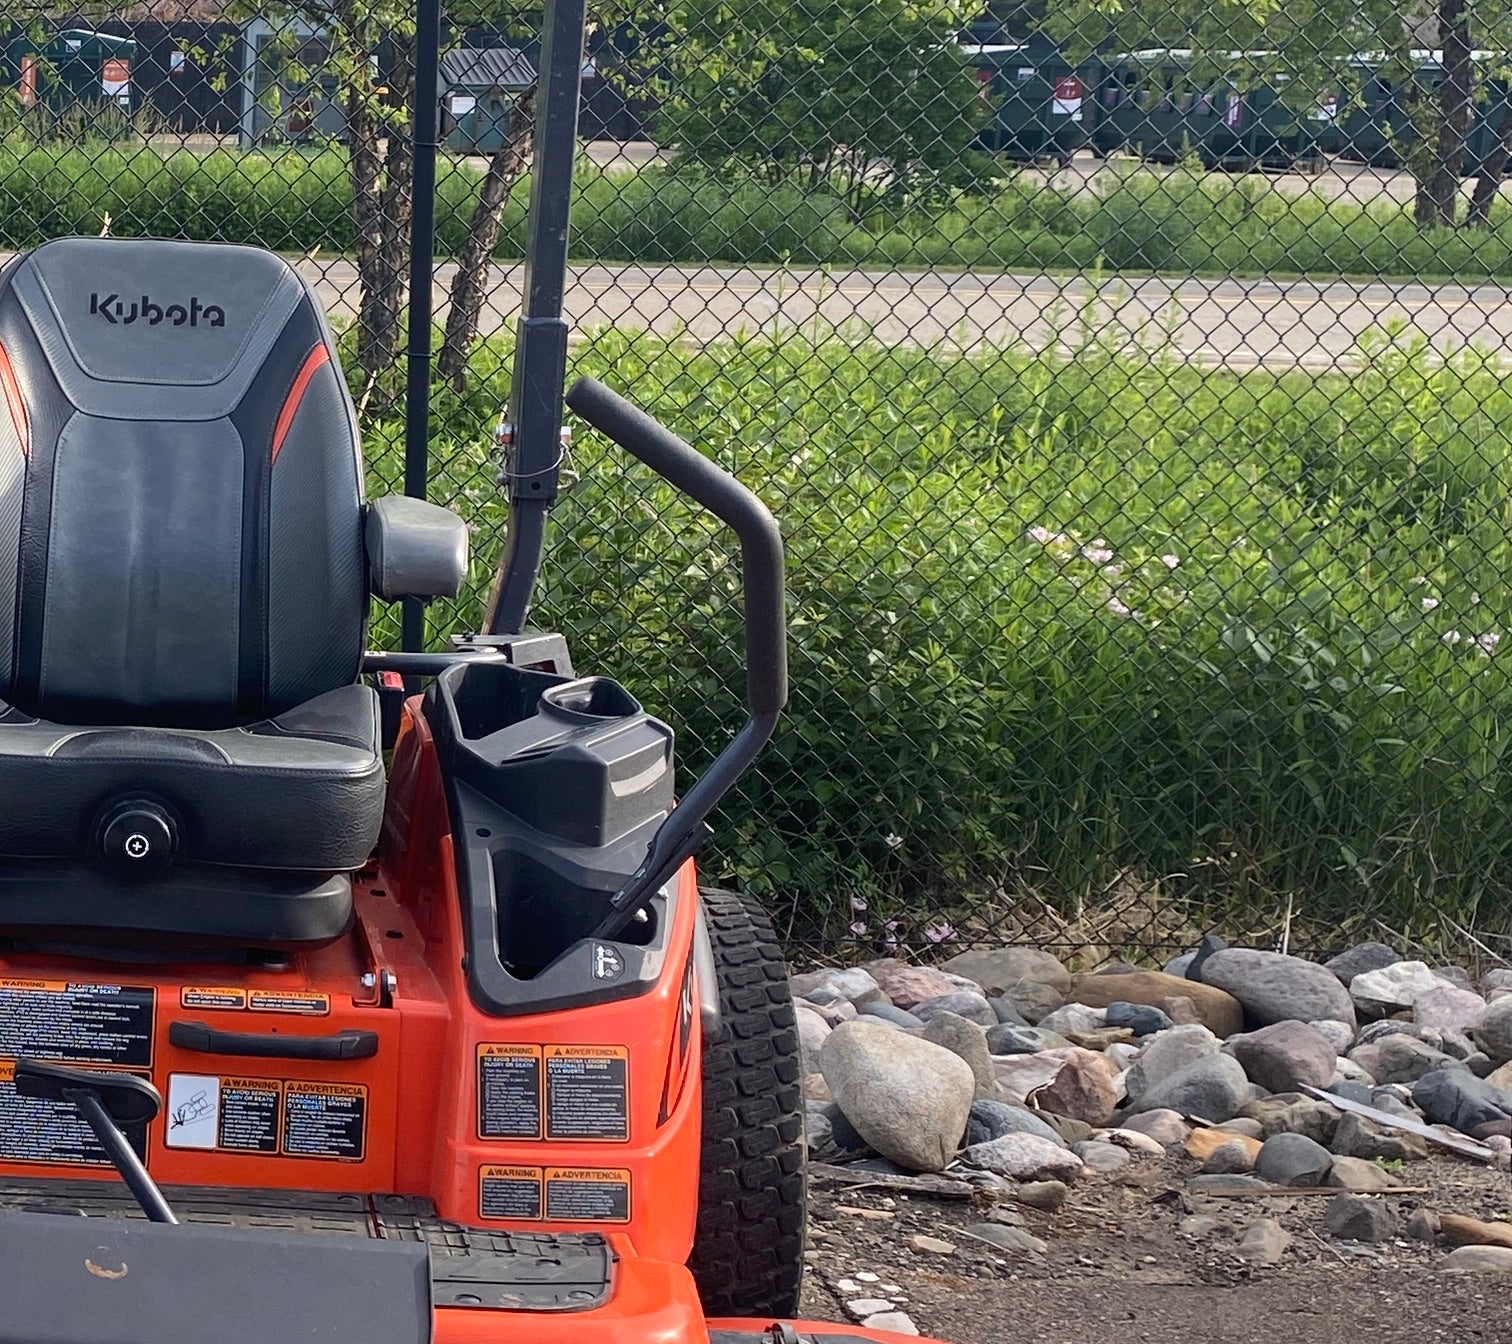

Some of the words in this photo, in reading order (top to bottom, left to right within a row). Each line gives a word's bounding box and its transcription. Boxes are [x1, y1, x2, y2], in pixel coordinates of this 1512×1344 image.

[90, 293, 225, 327] Kubota
[1, 980, 46, 988] WARNING
[263, 991, 324, 999] ADVERTENCIA
[496, 1047, 534, 1055] WARNING
[565, 1047, 618, 1056] ADVERTENCIA
[232, 1079, 279, 1090] WARNING
[296, 1083, 363, 1096] ADVERTENCIA
[495, 1168, 537, 1178] WARNING
[562, 1170, 623, 1180] ADVERTENCIA
